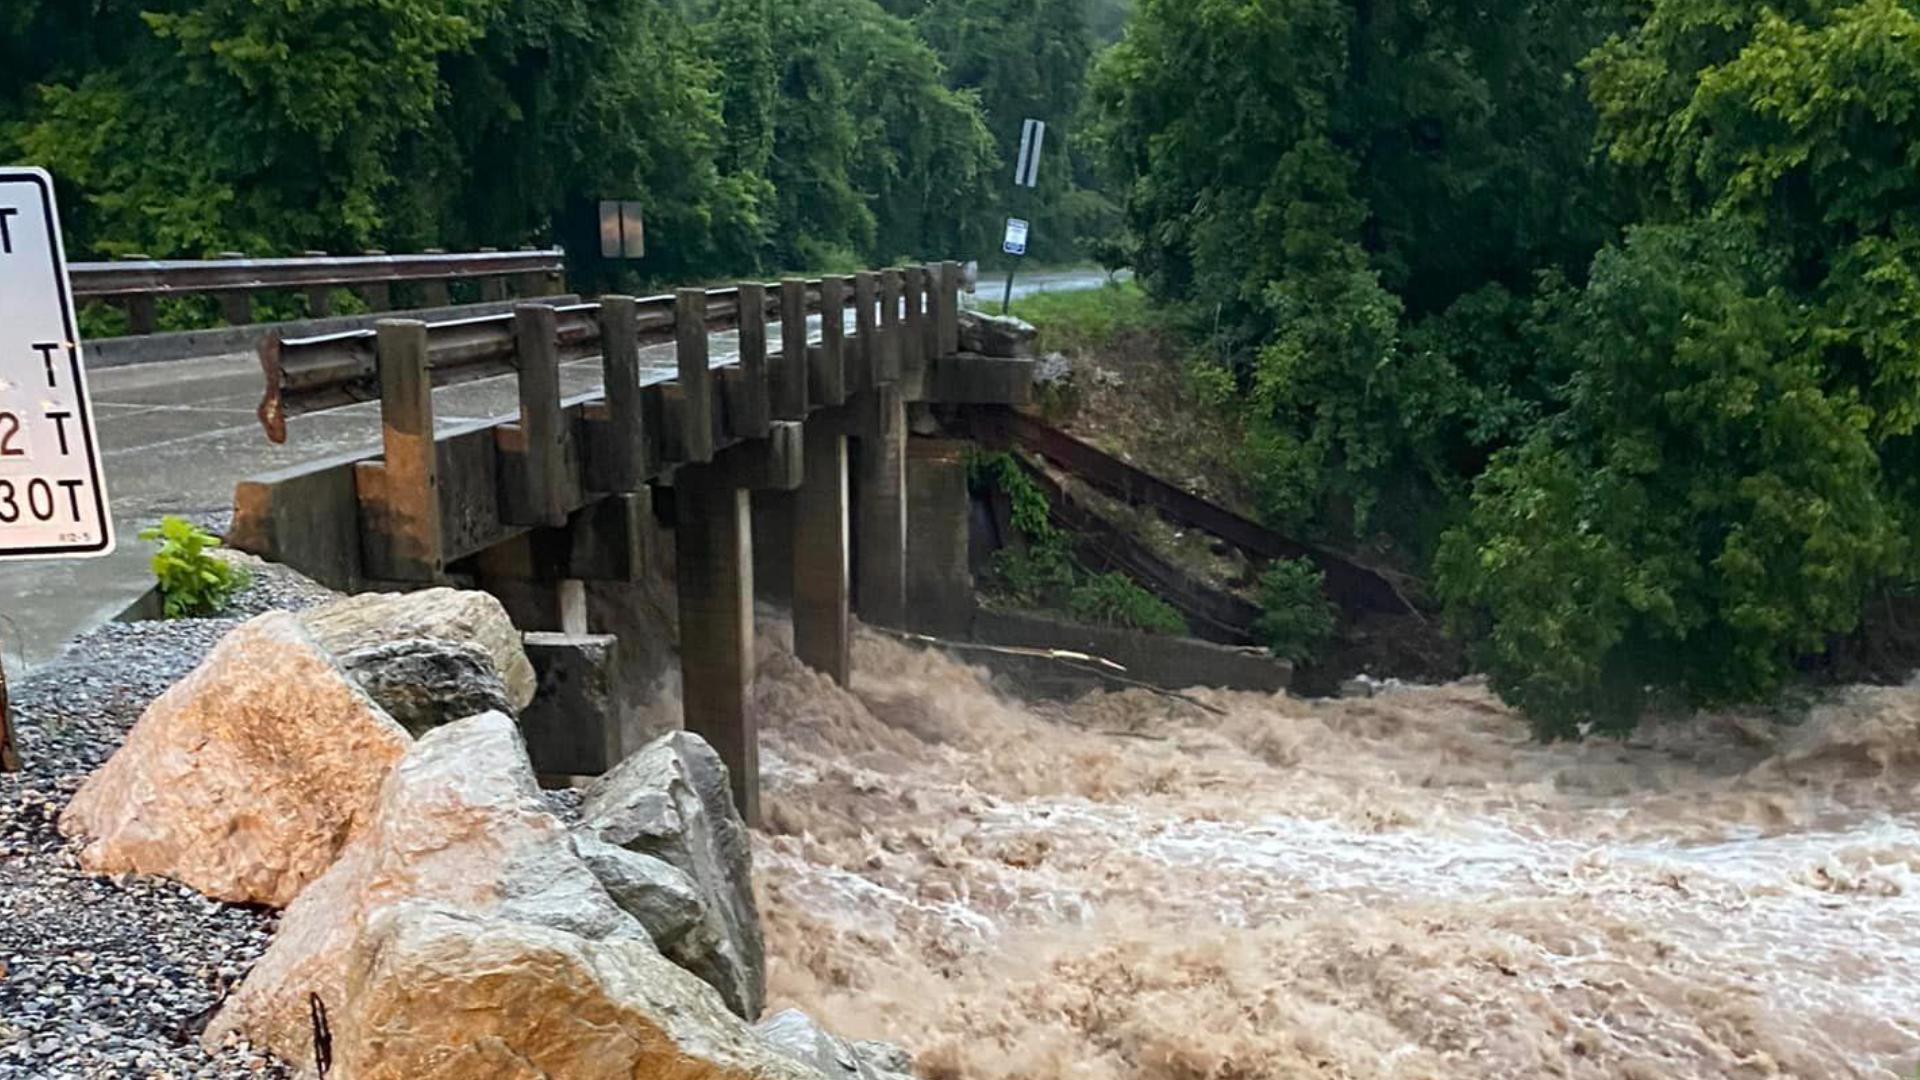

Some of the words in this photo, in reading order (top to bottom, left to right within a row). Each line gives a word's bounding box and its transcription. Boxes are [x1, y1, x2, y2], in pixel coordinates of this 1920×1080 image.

[0, 208, 18, 254] T
[32, 343, 59, 387] T
[0, 412, 24, 455] 2
[45, 412, 71, 455] T
